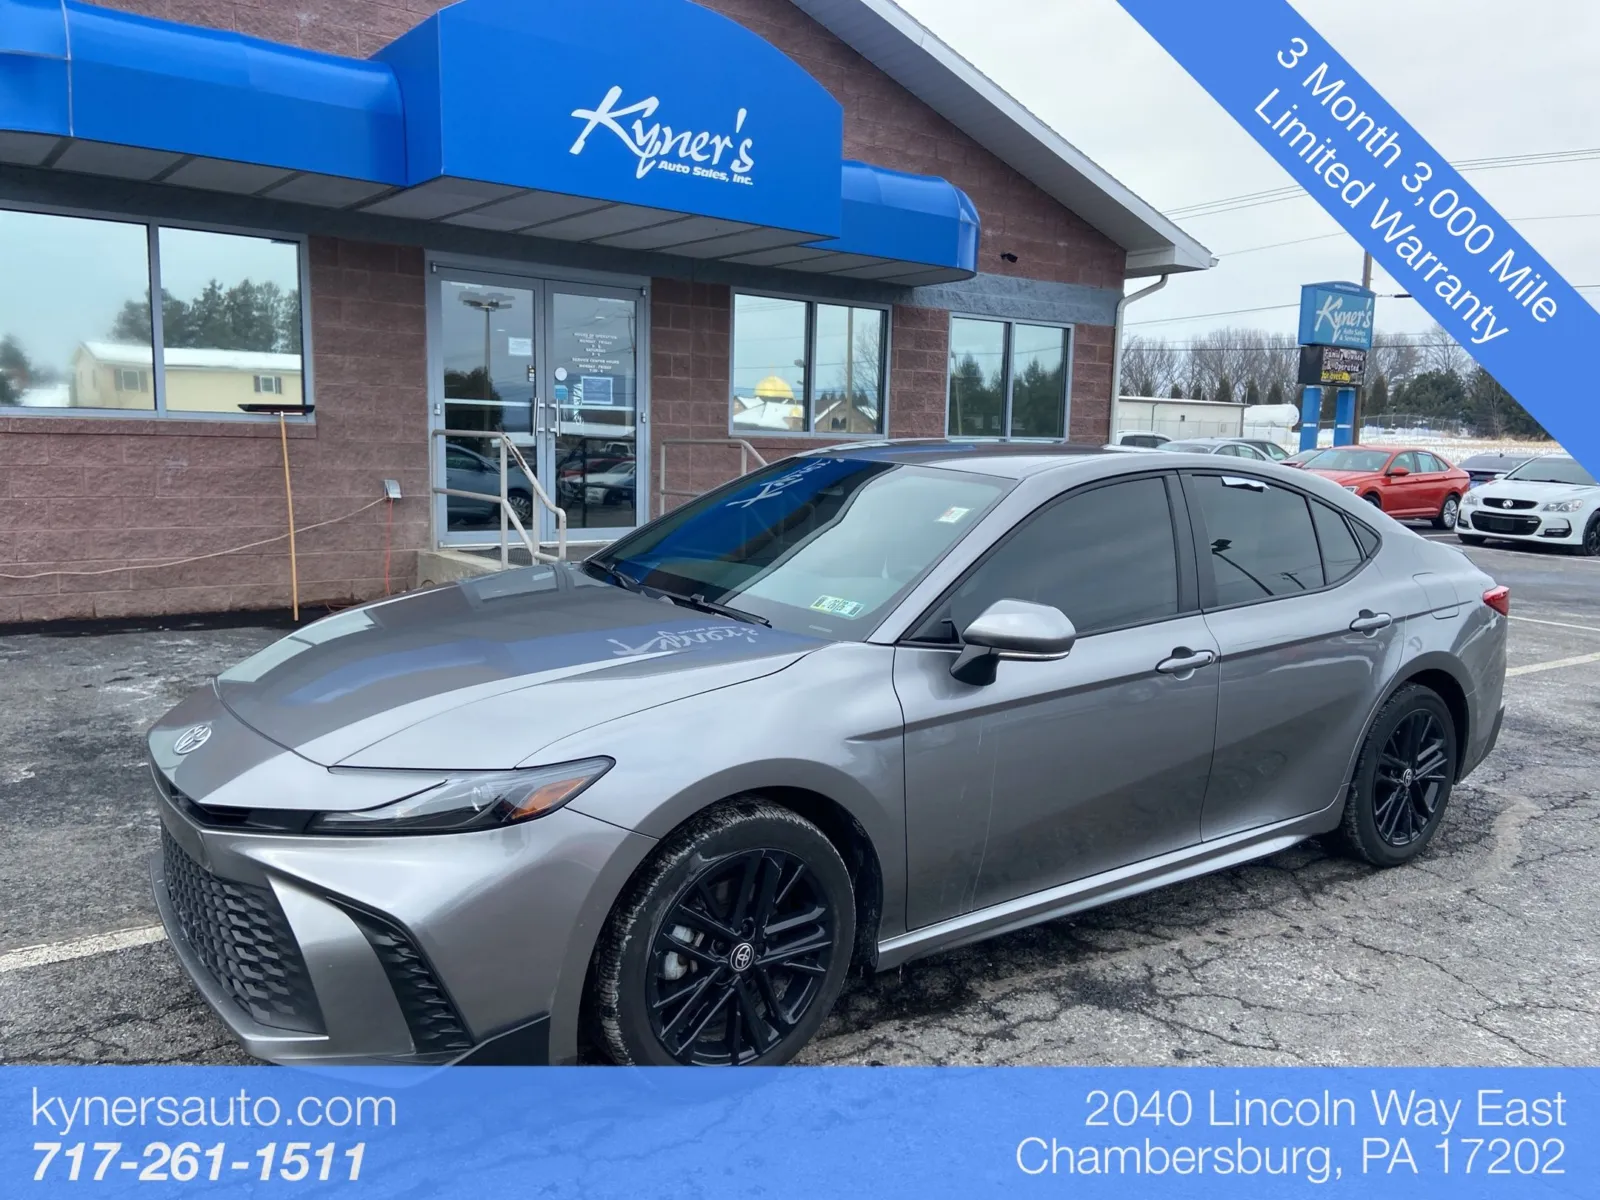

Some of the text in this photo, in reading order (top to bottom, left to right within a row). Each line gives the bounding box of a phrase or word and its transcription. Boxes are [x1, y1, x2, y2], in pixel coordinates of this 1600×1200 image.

[569, 85, 755, 179] Kyner's
[657, 160, 754, 186] Auto Sales, Inc.
[1315, 295, 1372, 344] Kyner's
